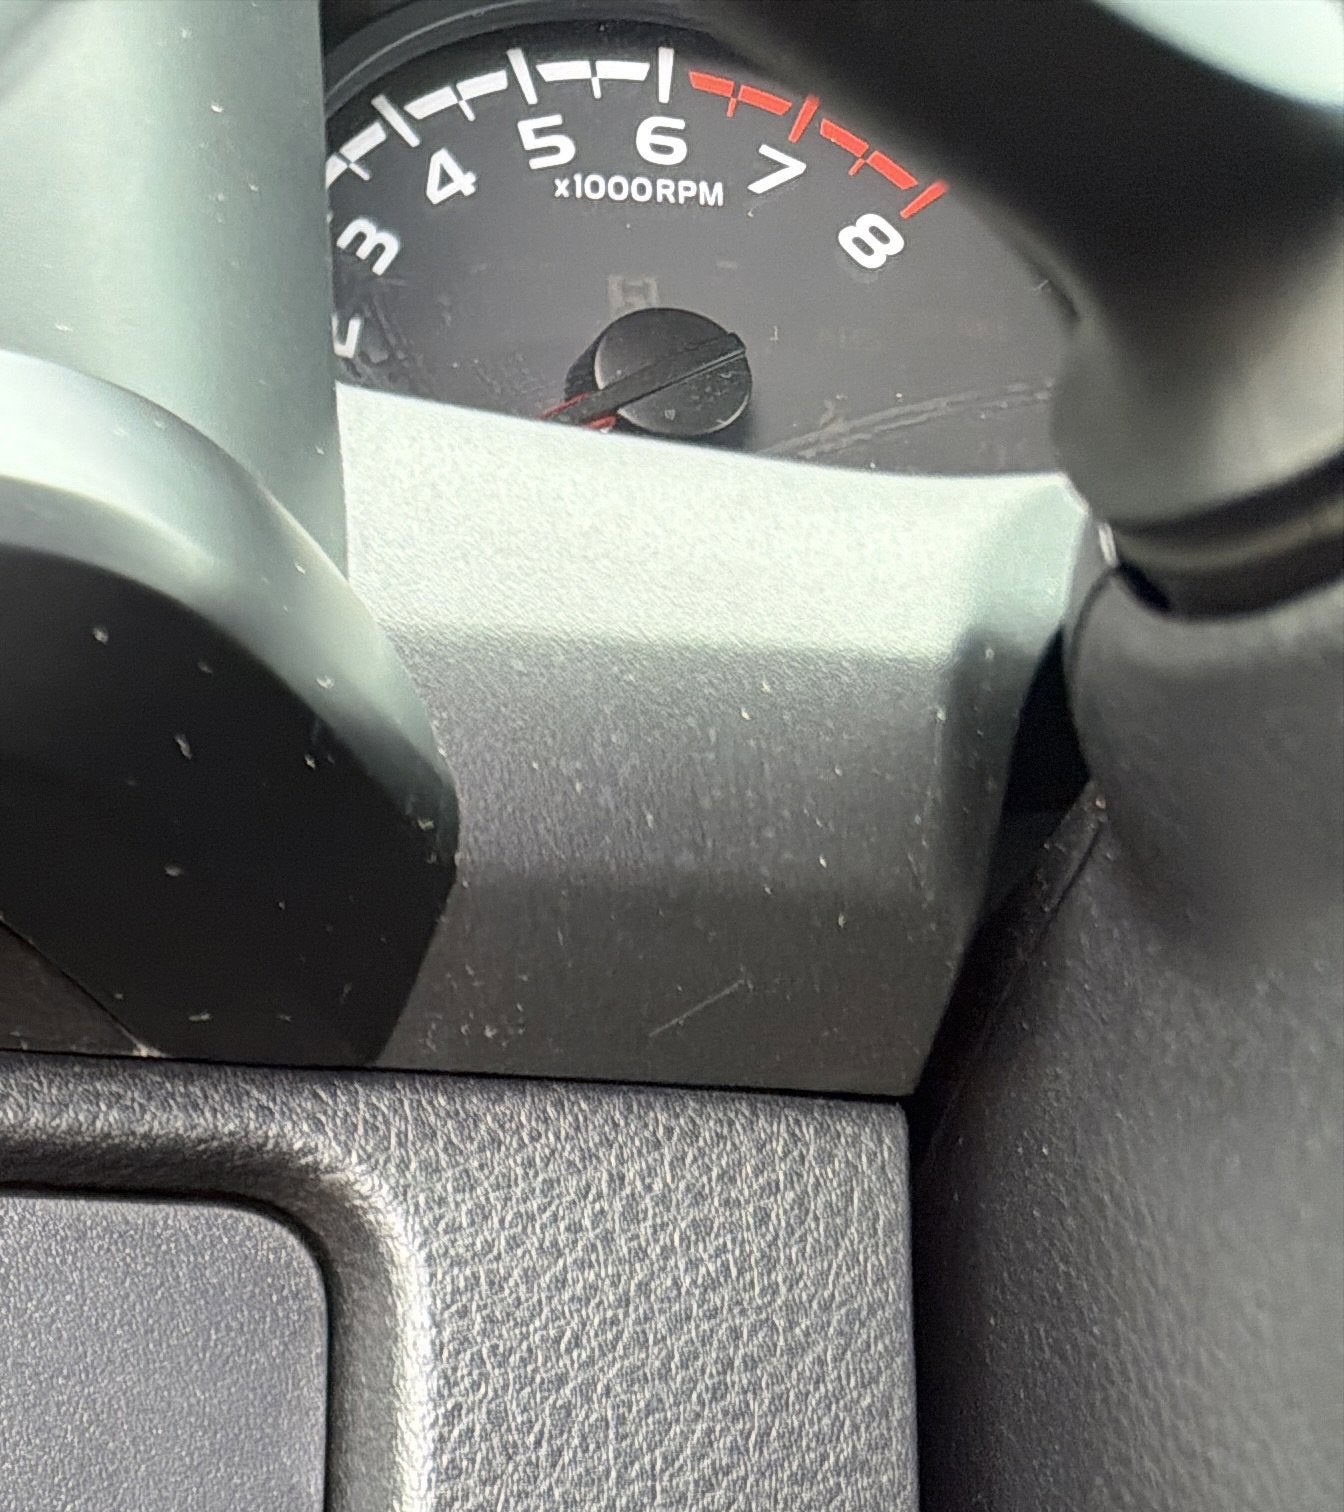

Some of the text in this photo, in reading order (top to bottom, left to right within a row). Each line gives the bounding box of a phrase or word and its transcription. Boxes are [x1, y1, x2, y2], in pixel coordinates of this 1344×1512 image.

[517, 113, 577, 170] 5
[635, 115, 688, 166] 6
[425, 147, 477, 205] 4
[746, 143, 807, 195] 7
[336, 218, 400, 276] 3
[837, 213, 905, 269] 8
